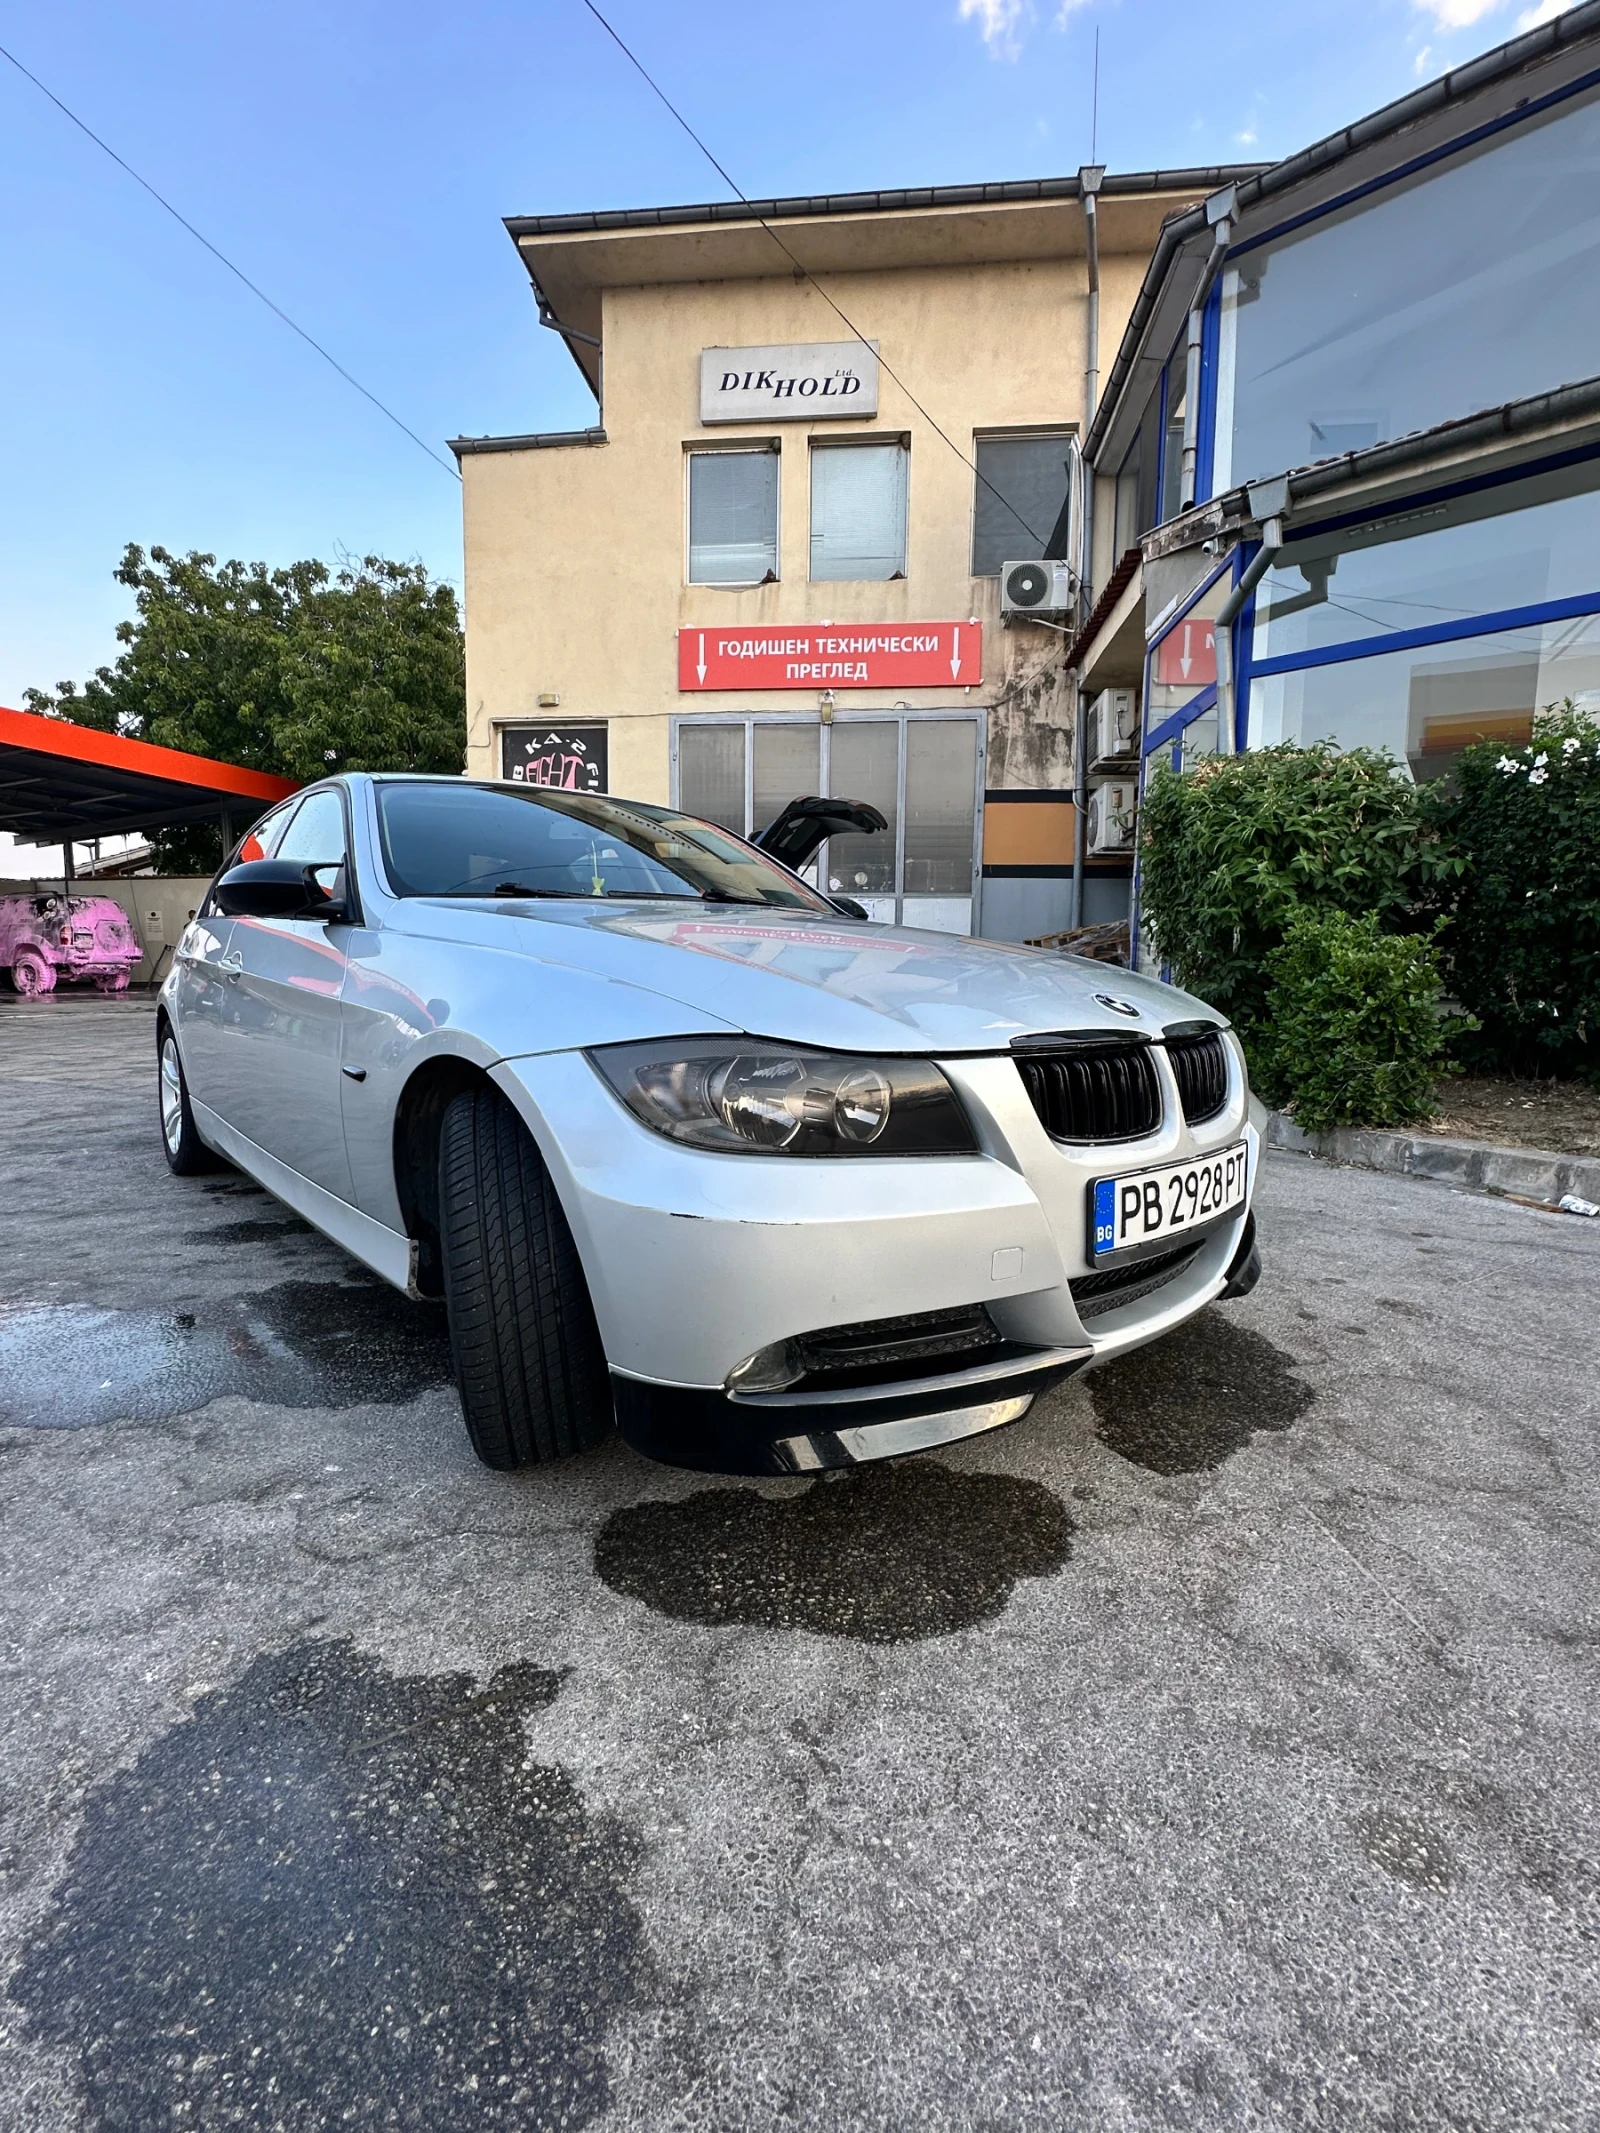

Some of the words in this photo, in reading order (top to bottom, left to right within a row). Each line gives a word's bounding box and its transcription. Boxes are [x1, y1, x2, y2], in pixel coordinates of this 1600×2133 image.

[835, 369, 855, 377] Ltd.
[718, 638, 810, 659] ГОДИШЕН
[815, 636, 939, 654] ТЕХНИЧЕСКИ
[786, 662, 868, 681] ПРЕГЛЕД
[1097, 1224, 1113, 1242] BG
